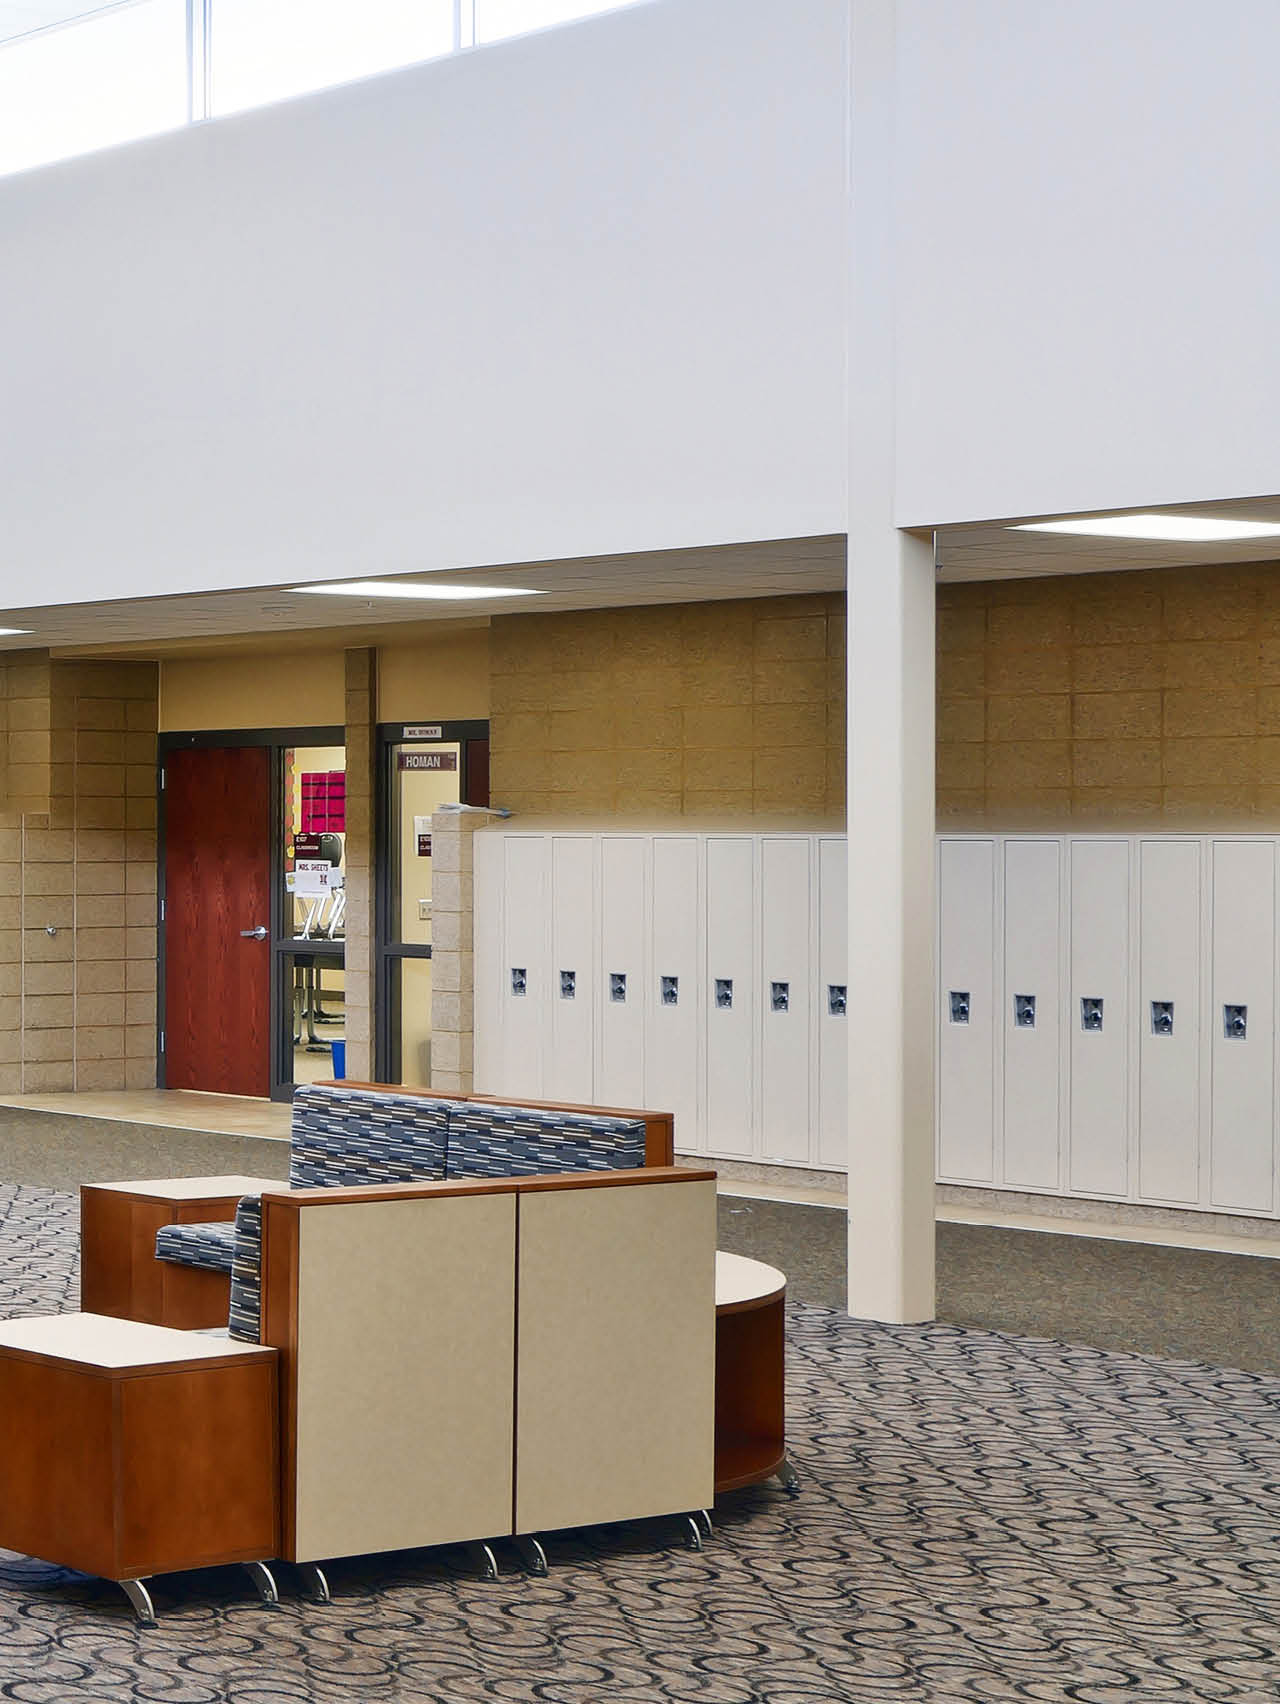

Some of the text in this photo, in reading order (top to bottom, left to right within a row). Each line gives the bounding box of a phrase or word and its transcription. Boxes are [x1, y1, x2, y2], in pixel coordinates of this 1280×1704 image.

[406, 756, 440, 768] HOMAN
[298, 863, 329, 871] MRS. SHEETS
